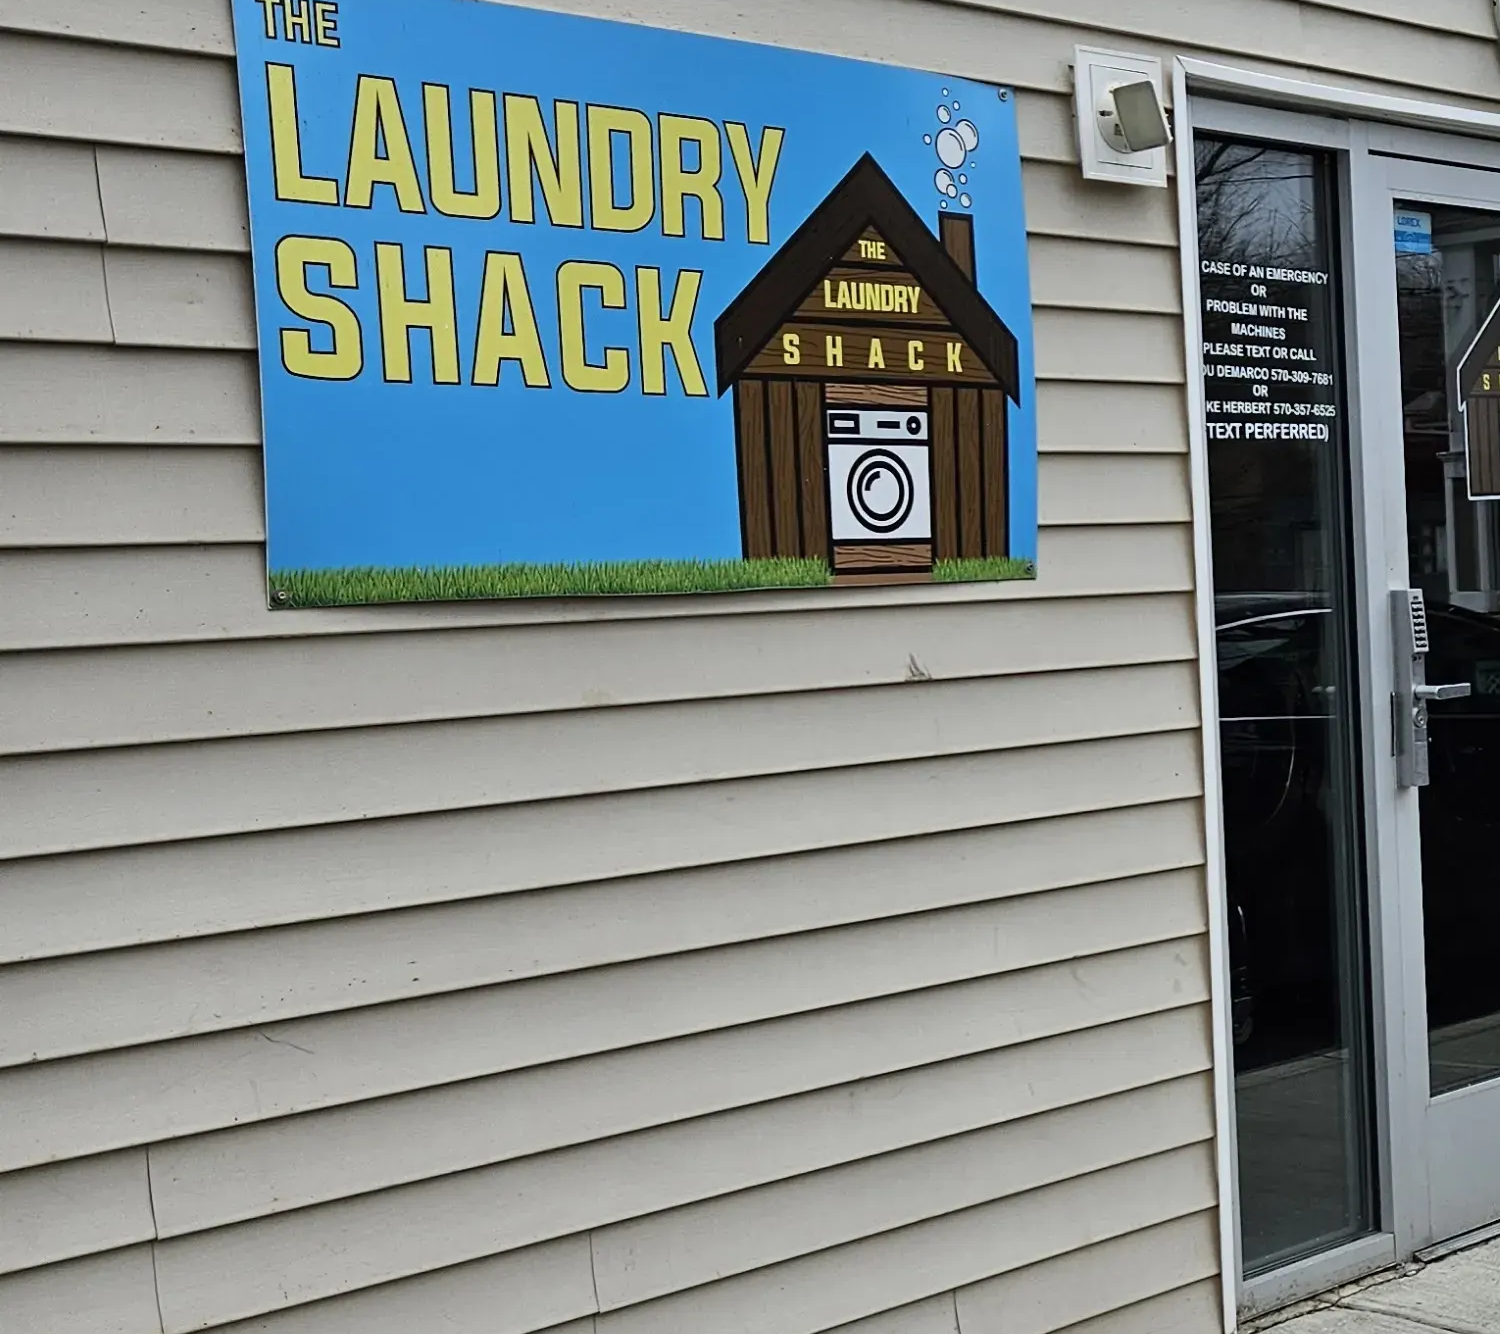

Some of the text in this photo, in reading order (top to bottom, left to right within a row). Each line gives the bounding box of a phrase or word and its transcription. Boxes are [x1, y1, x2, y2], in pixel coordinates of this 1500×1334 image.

[265, 61, 786, 246] LAUNDRY
[858, 239, 886, 262] THE
[1201, 260, 1329, 285] CASE OF AN EMERGENCY
[823, 279, 921, 315] LAUNDRY
[1250, 284, 1267, 298] OR
[275, 234, 709, 399] SHACK
[1206, 299, 1309, 321] PROBLEM WITH THE
[1230, 322, 1286, 340] MACHINES
[783, 333, 964, 375] SHACK
[1203, 342, 1317, 361] PLEASE TEXT OR CALL
[1216, 364, 1269, 380] DEMARCO
[1252, 384, 1269, 398] OR
[1222, 401, 1272, 415] HERBERT
